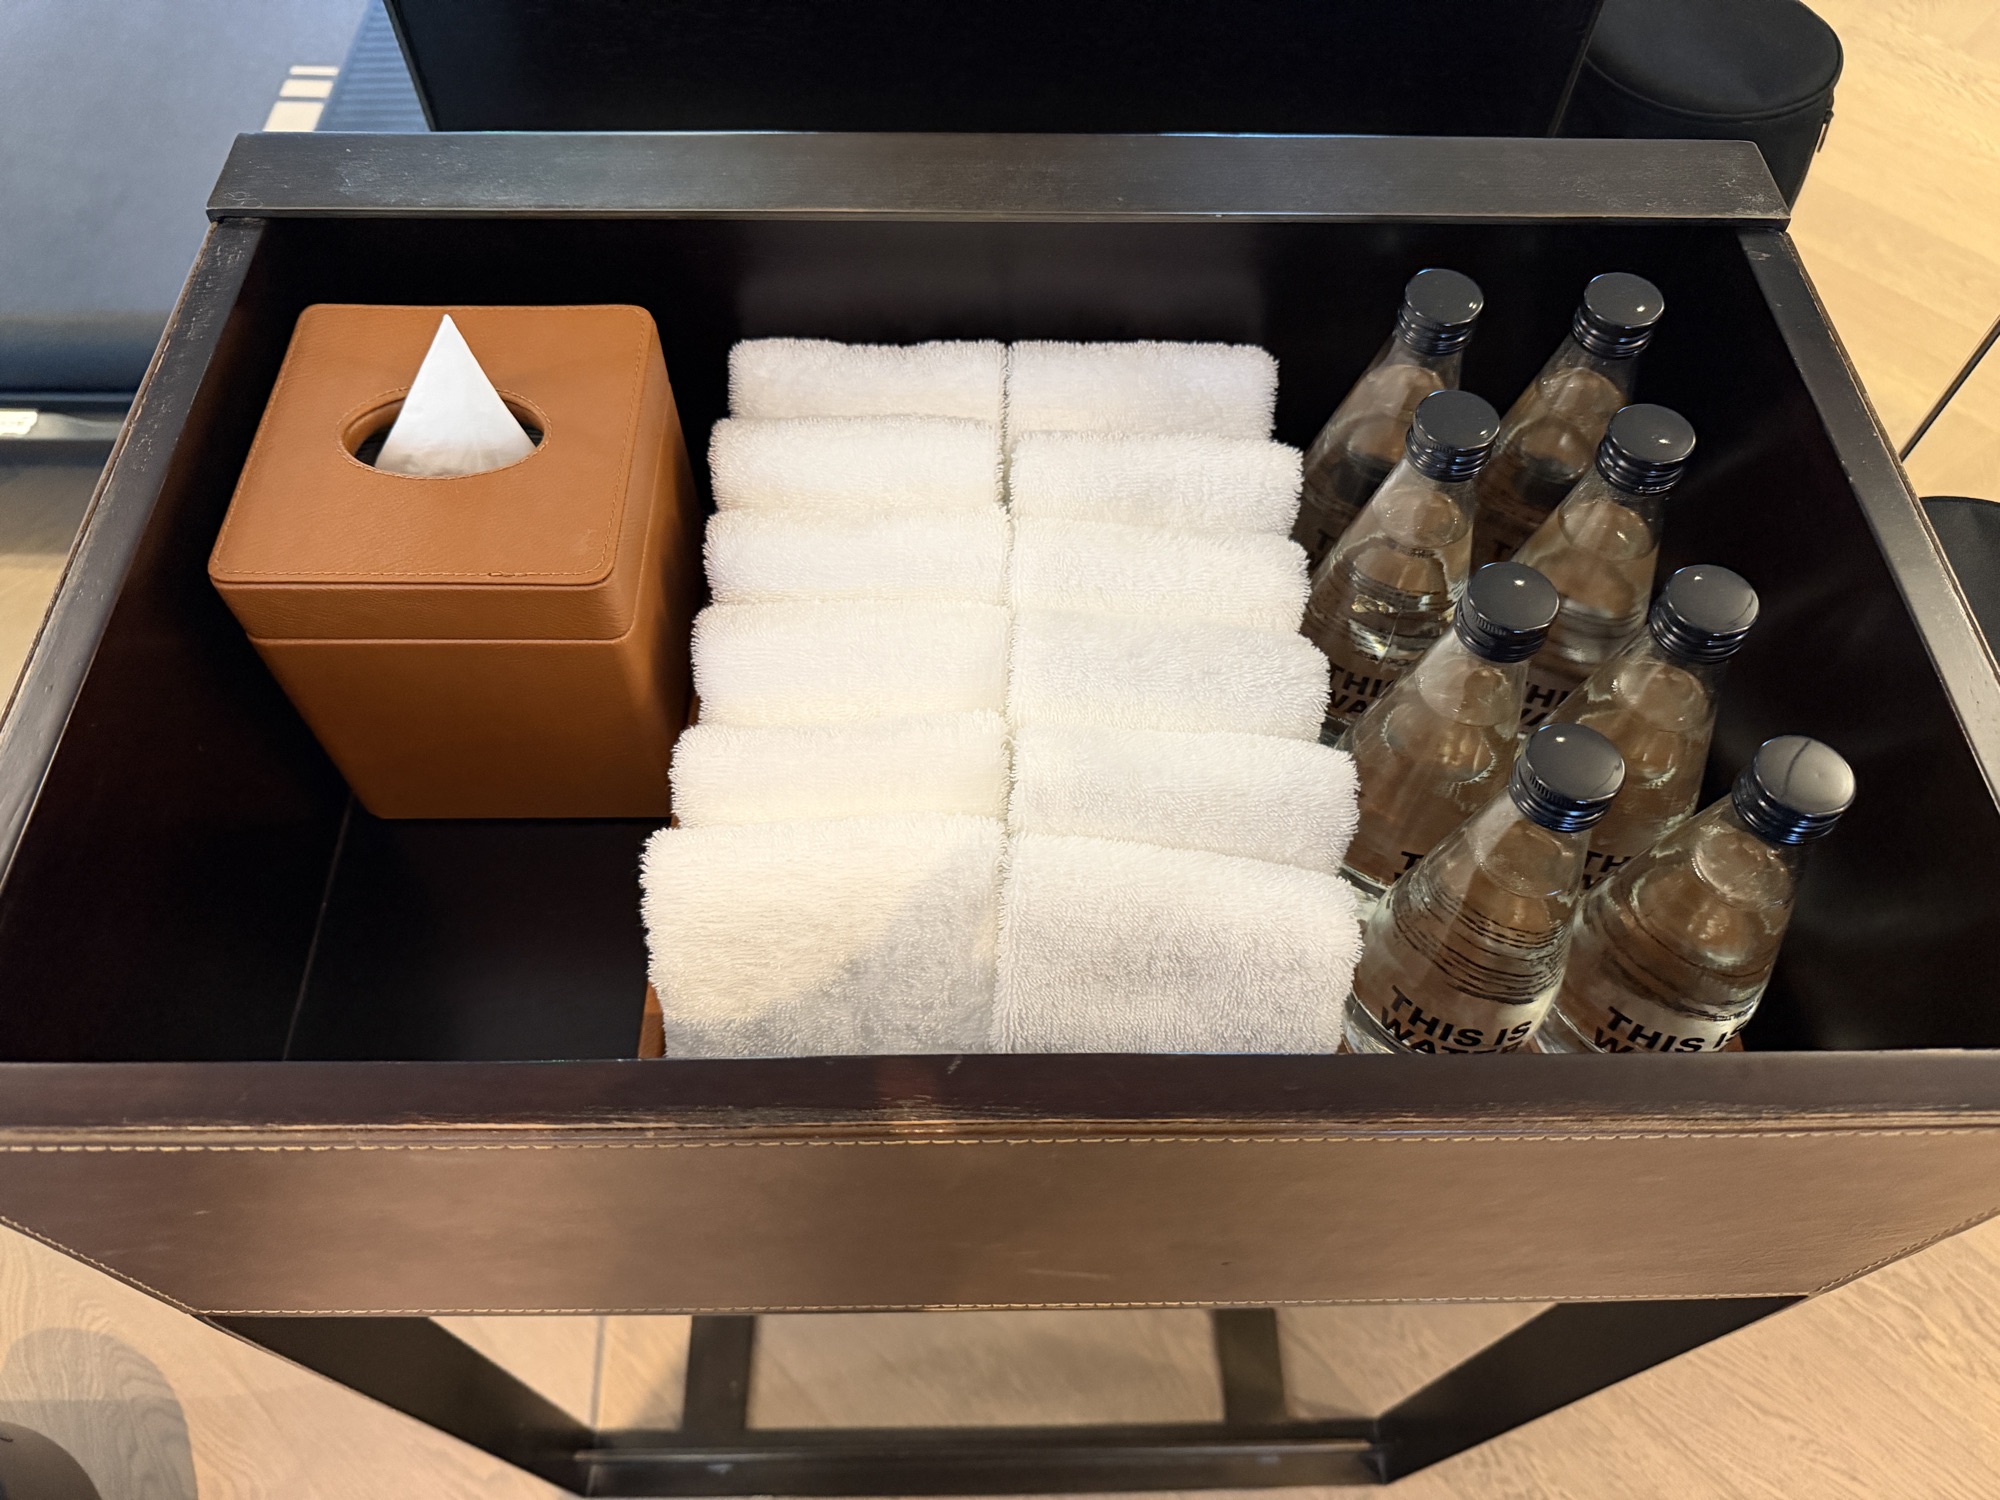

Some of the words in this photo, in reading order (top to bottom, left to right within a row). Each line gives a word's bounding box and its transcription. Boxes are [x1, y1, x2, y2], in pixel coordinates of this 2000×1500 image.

[1328, 662, 1395, 698] THI
[1392, 984, 1484, 1047] THIS
[1494, 1020, 1533, 1047] IS
[1607, 1005, 1706, 1053] THIS
